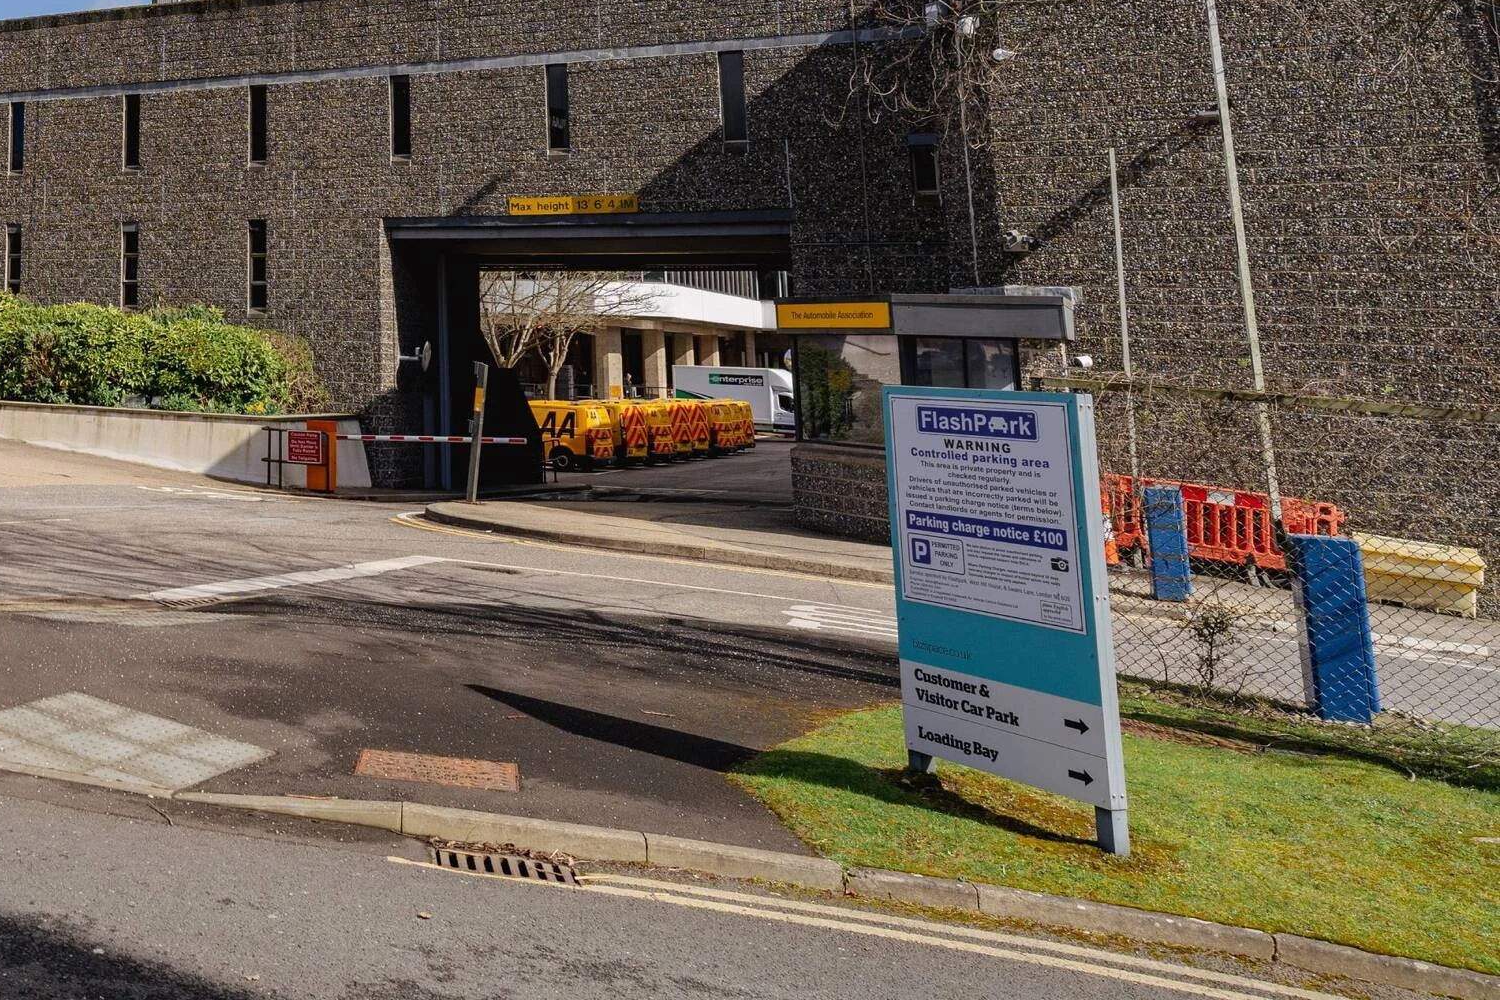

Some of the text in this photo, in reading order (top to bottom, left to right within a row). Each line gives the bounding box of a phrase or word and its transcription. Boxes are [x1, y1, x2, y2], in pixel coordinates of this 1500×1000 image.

[510, 202, 532, 211] Max
[537, 202, 570, 212] height
[791, 311, 874, 320] The Automobile Association
[710, 375, 763, 385] enterprise
[540, 411, 575, 439] AA
[943, 438, 1011, 454] WARNING
[910, 447, 1050, 469] Controlled parking area
[920, 460, 935, 468] This
[960, 464, 984, 472] private
[986, 467, 1017, 477] property
[948, 472, 977, 480] checked
[908, 484, 936, 493] vehicles
[937, 487, 951, 495] that
[965, 490, 1004, 502] incorrectly
[1005, 495, 1032, 504] parked
[1049, 499, 1059, 507] be
[909, 475, 933, 484] Drivers
[943, 480, 988, 490] unauthorised
[989, 485, 1014, 493] parked
[1016, 487, 1047, 497] vehicles
[906, 491, 928, 500] issued
[934, 495, 960, 505] parking
[961, 498, 986, 508] charge
[1011, 503, 1035, 513] (terms
[909, 500, 935, 509] Contact
[936, 503, 968, 513] landlords
[978, 509, 1003, 518] agents
[1004, 511, 1015, 519] for
[909, 513, 1064, 546] Parking charge notice £100
[914, 541, 928, 560] P
[931, 540, 961, 551] PERMITTED
[934, 550, 959, 560] PARKING
[939, 560, 954, 569] ONLY
[913, 668, 991, 699] Customer &
[915, 687, 1020, 727] Visitor Car Park
[917, 725, 1000, 763] Loading Bay
